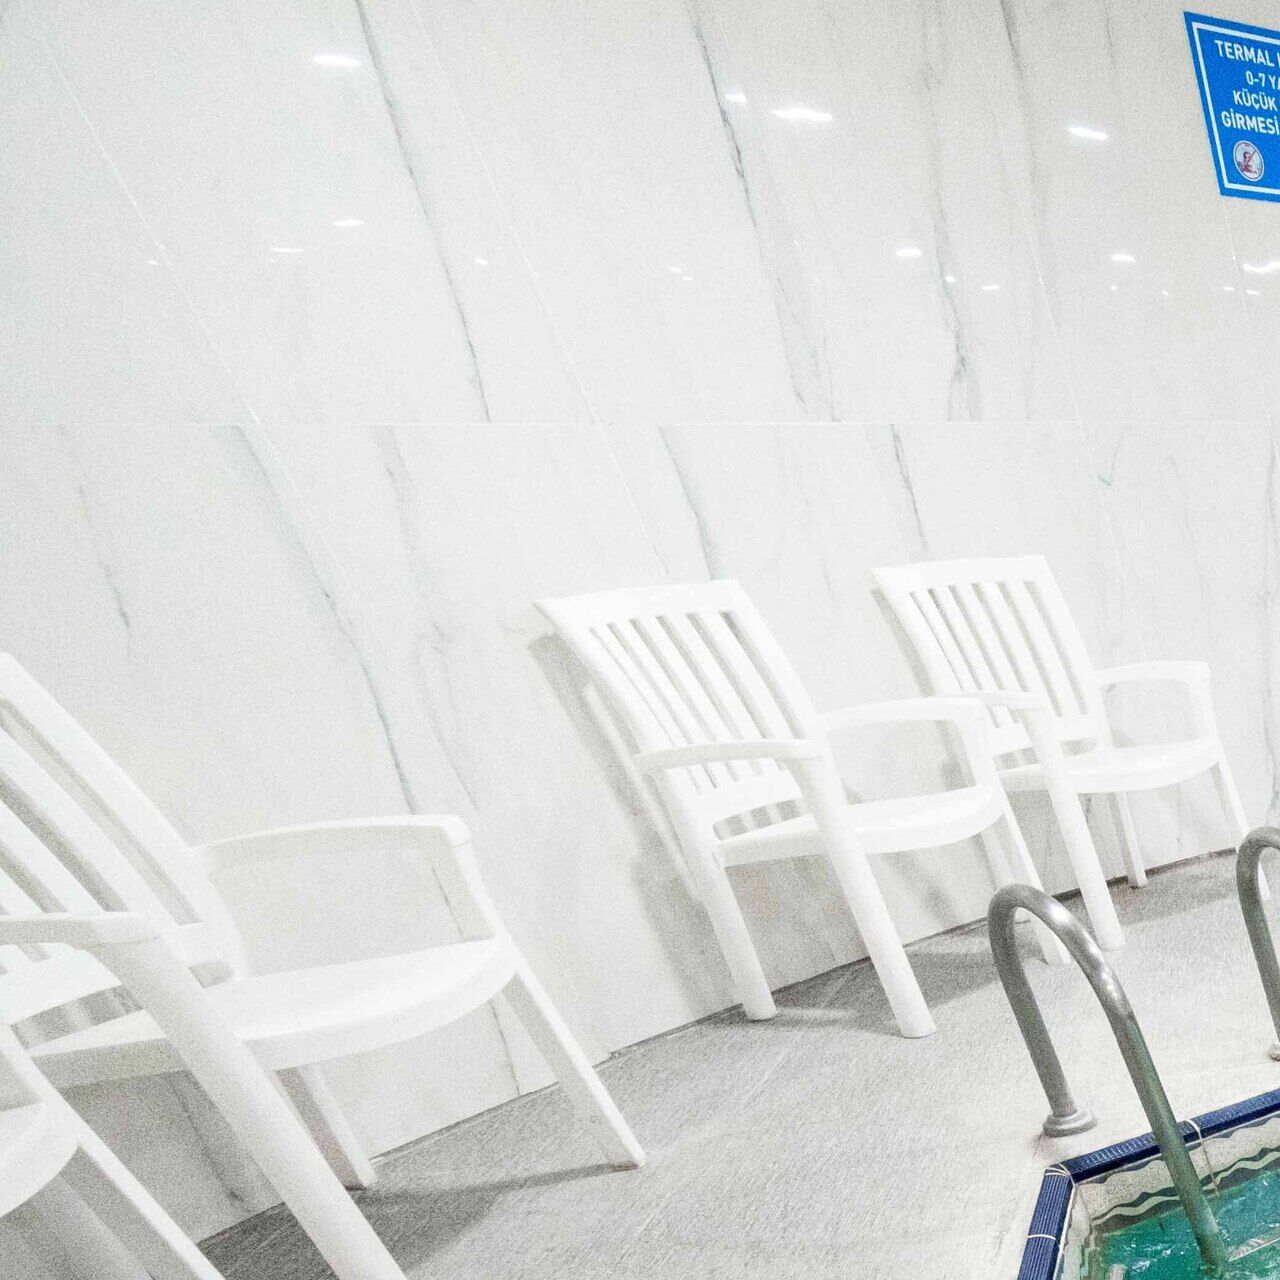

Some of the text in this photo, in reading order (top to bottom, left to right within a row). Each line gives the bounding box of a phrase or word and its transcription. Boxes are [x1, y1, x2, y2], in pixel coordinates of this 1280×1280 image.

[1214, 39, 1275, 73] TERMAL
[1245, 70, 1266, 87] 0-7
[1233, 89, 1277, 112] KÜÇÜK
[1221, 108, 1280, 136] GİRMESİ
